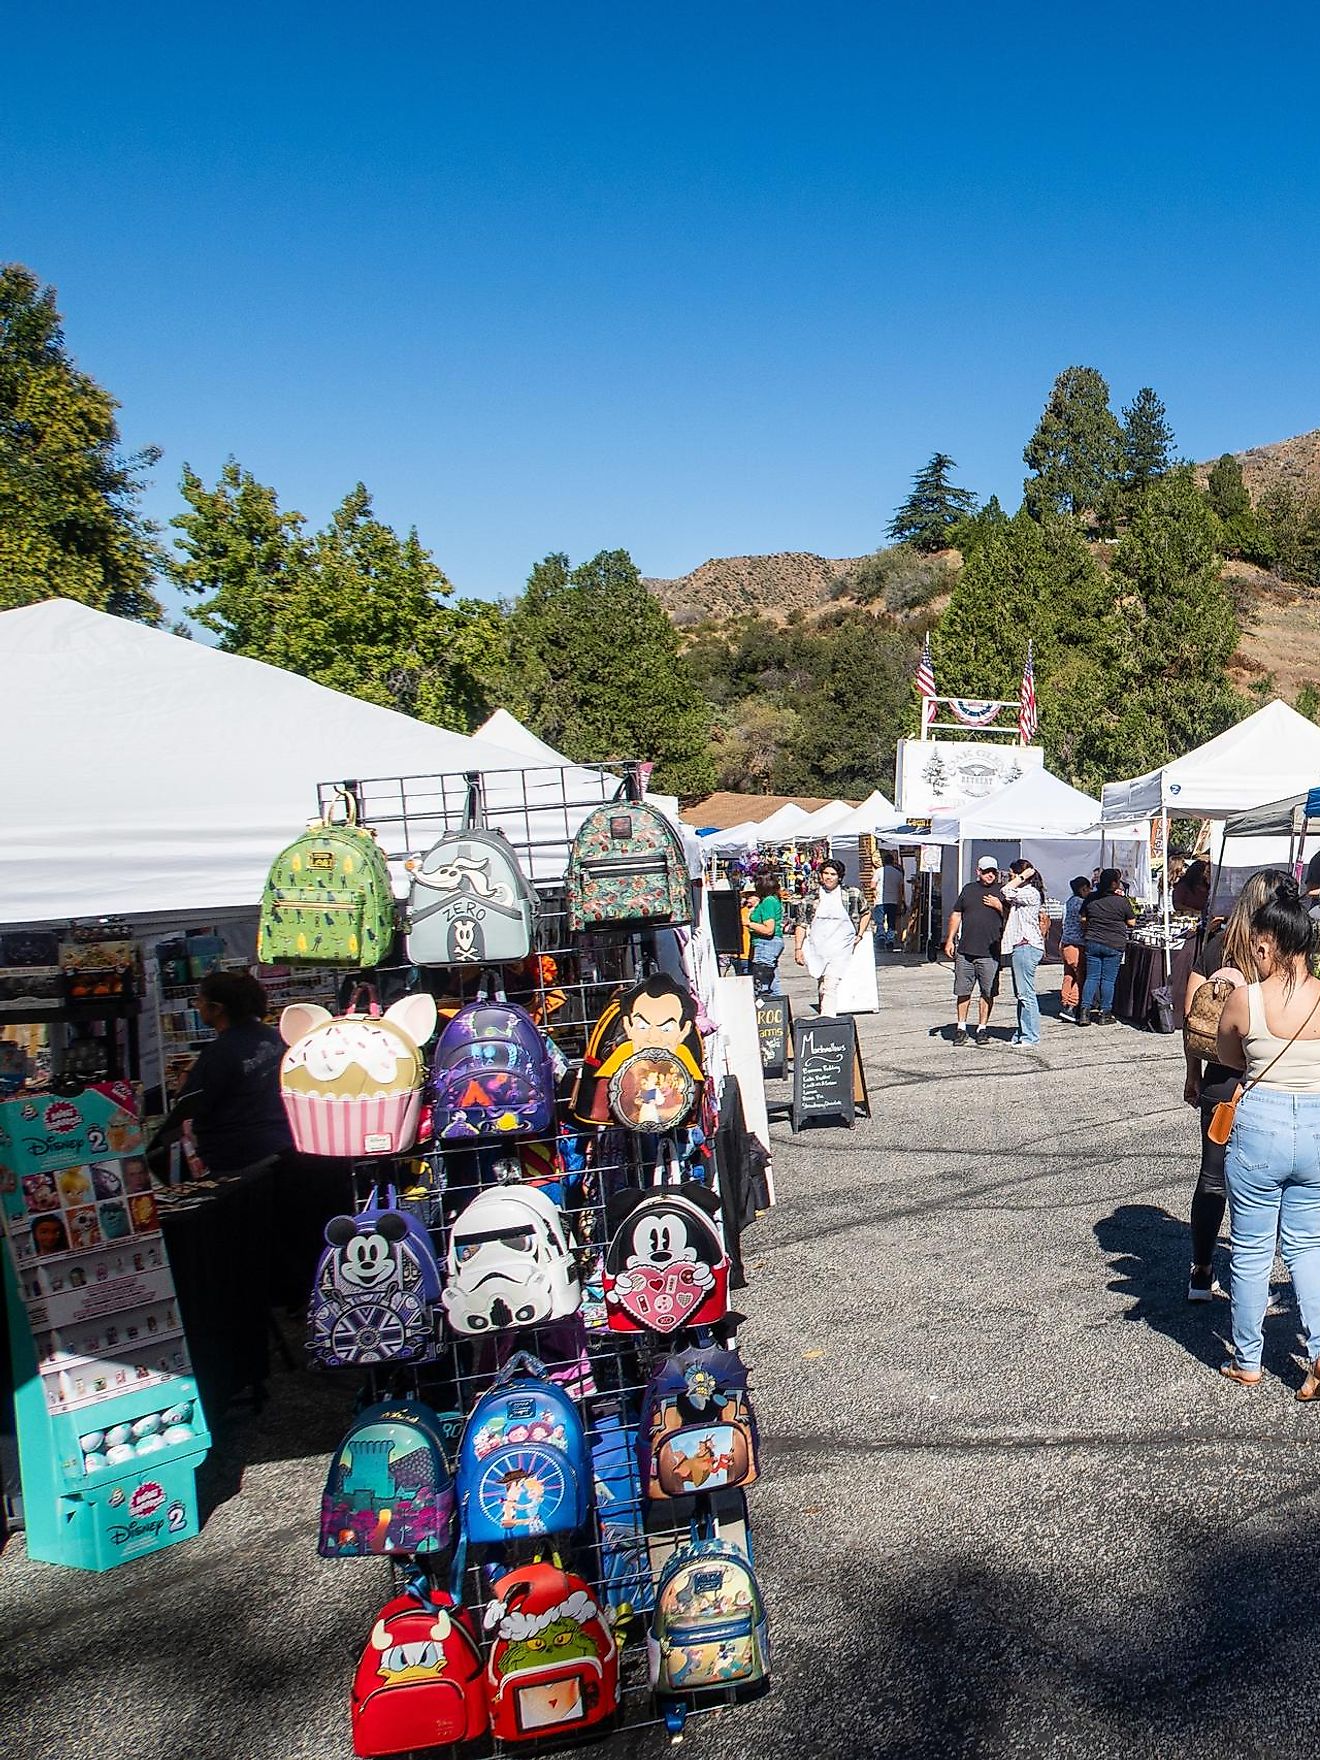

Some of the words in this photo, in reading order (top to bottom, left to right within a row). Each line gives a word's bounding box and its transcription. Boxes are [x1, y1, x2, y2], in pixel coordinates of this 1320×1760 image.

[442, 901, 486, 922] ZERO
[759, 1027, 784, 1038] arms
[23, 1136, 83, 1156] Disney
[88, 1130, 110, 1155] 2
[106, 1519, 164, 1545] Disney
[167, 1506, 188, 1534] 2
